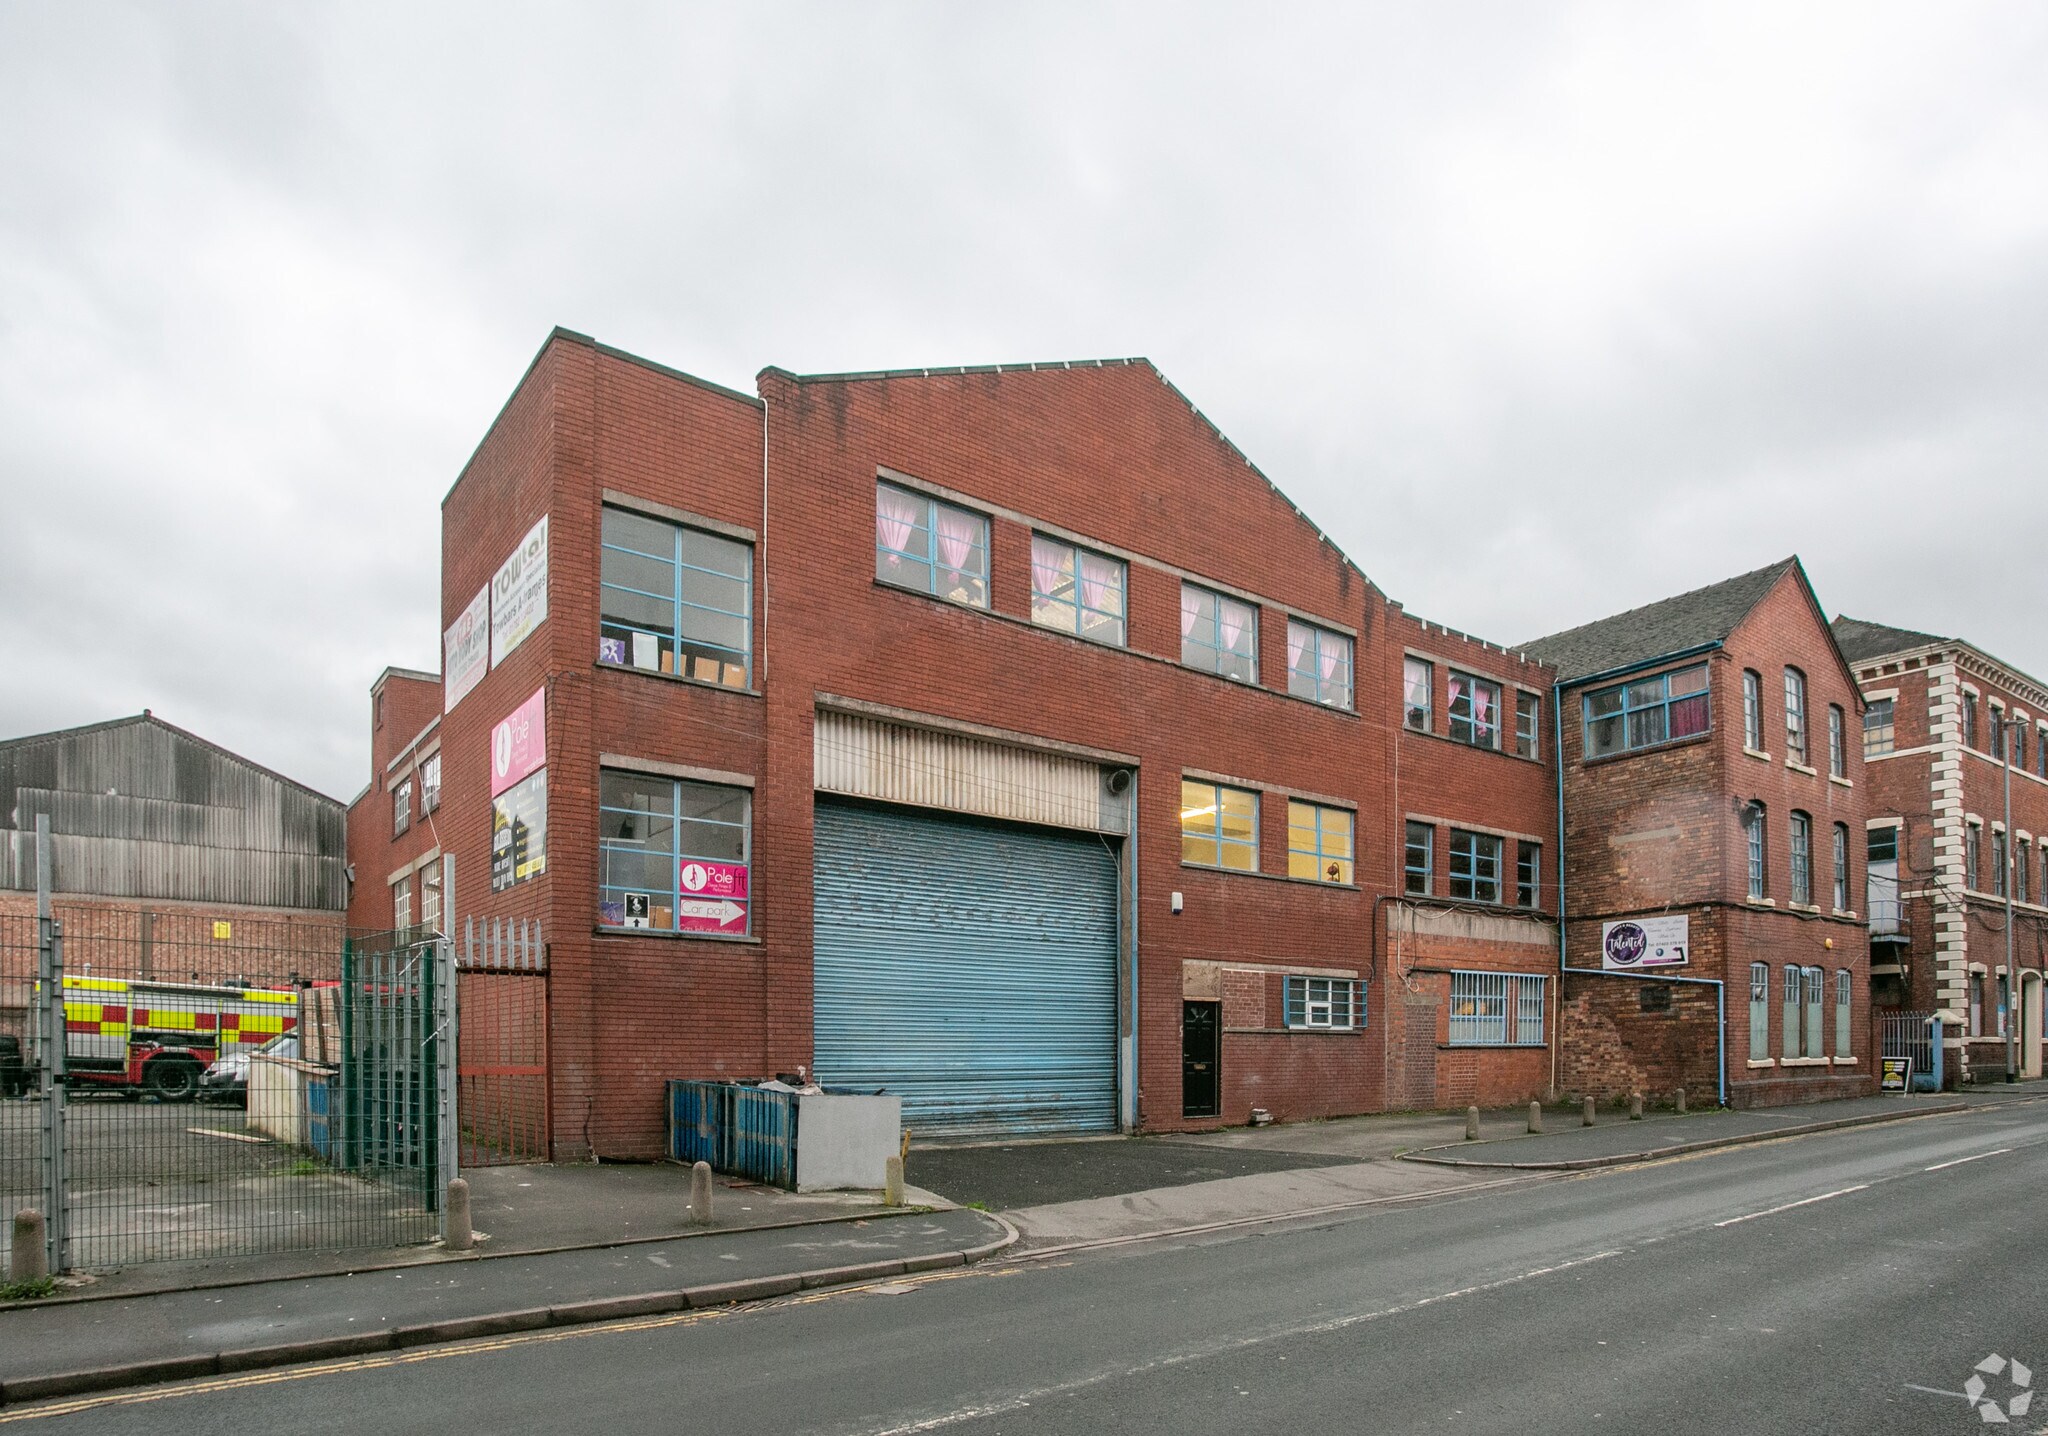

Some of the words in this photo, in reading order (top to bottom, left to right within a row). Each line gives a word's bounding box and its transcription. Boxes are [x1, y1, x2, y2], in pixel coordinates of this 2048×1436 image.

[472, 617, 485, 649] SHOP
[493, 604, 517, 637] Towbars
[682, 901, 703, 914] Car
[707, 904, 730, 918] park
